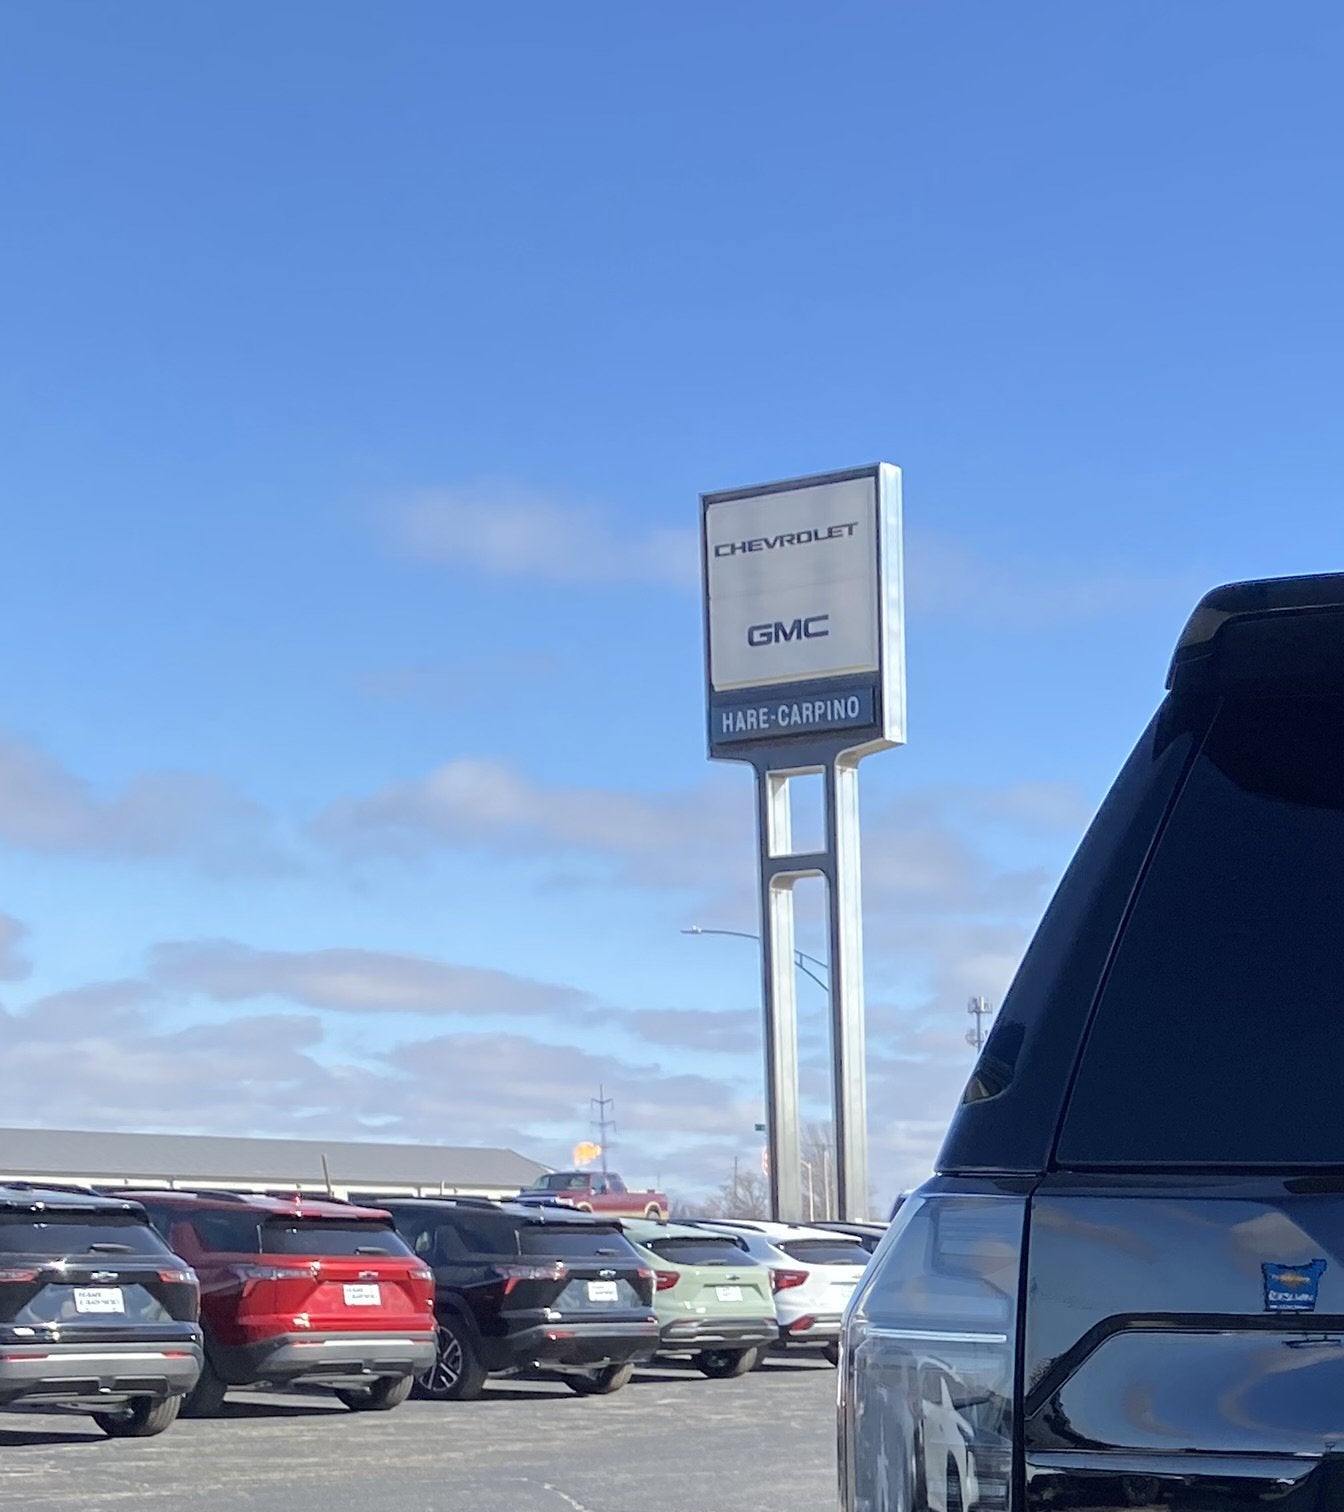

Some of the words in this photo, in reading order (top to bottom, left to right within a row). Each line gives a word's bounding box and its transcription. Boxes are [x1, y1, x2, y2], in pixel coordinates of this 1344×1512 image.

[714, 522, 859, 557] CHEVROLET
[747, 614, 830, 648] GMC
[722, 696, 860, 733] HARE-CARPINO
